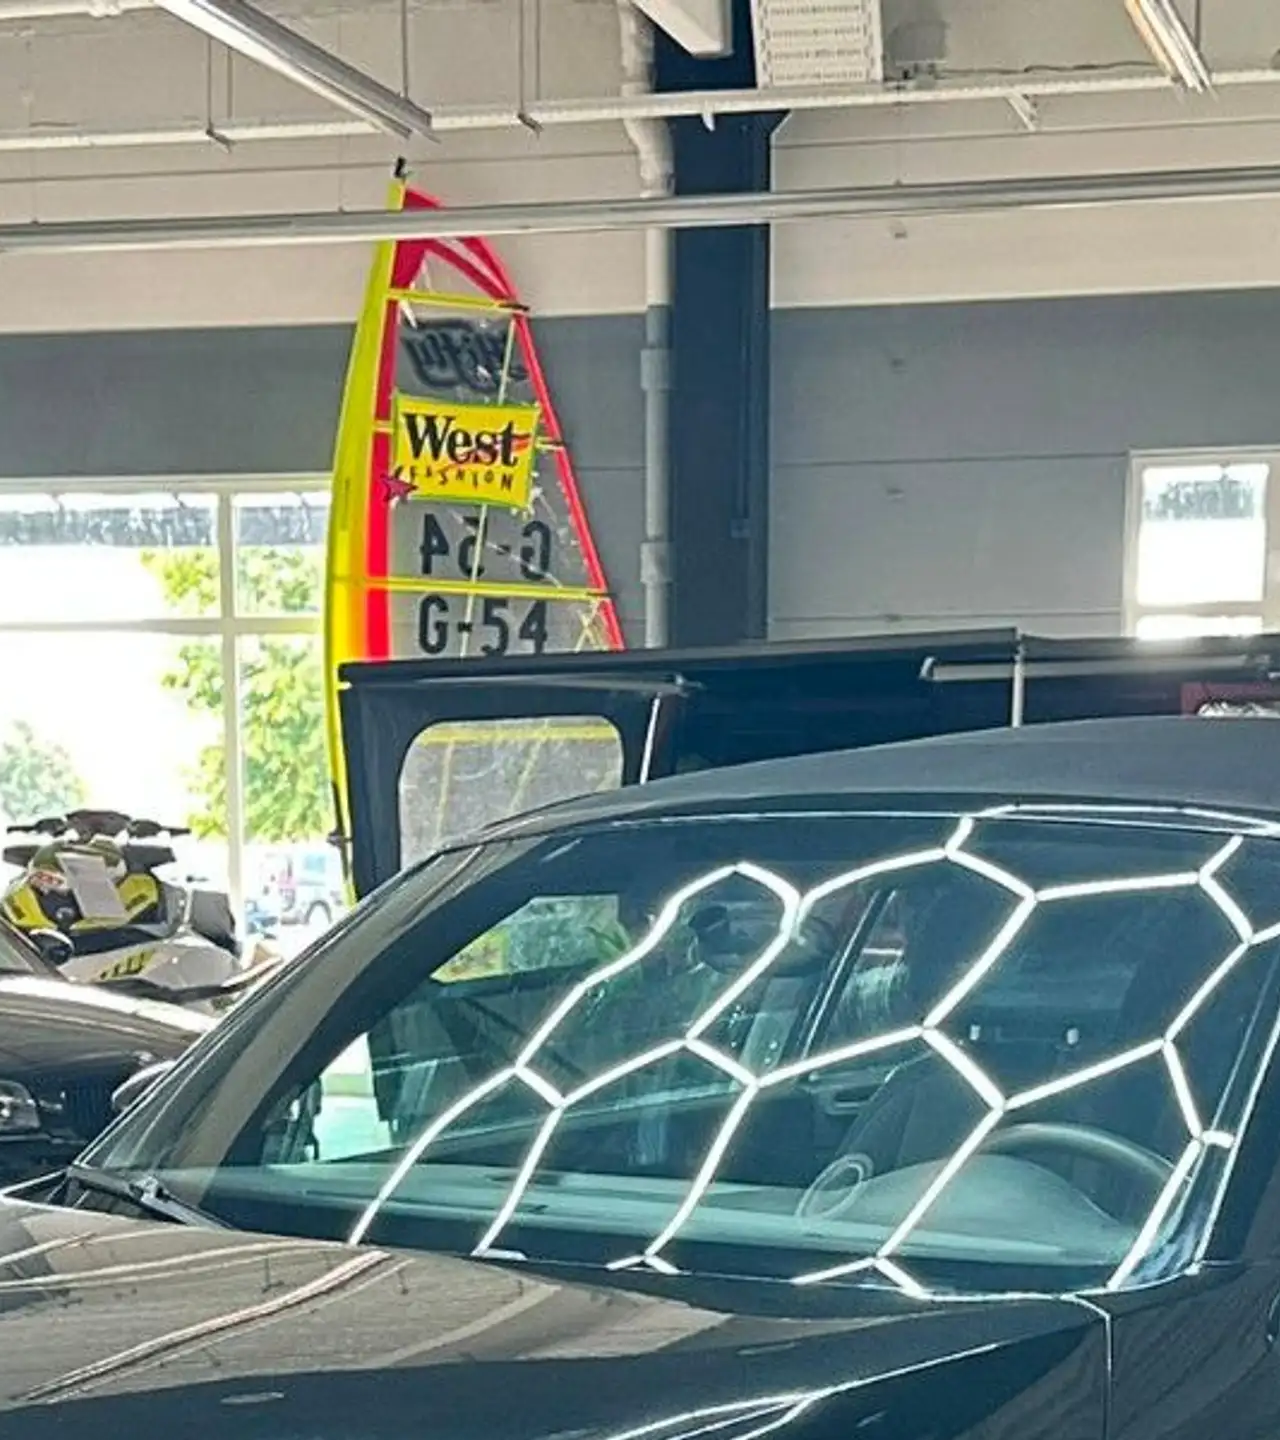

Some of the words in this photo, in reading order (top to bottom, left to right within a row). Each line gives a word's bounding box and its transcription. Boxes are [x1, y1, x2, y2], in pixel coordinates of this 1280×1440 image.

[402, 412, 518, 468] West
[408, 464, 513, 492] FASHION
[419, 594, 549, 656] G-54
